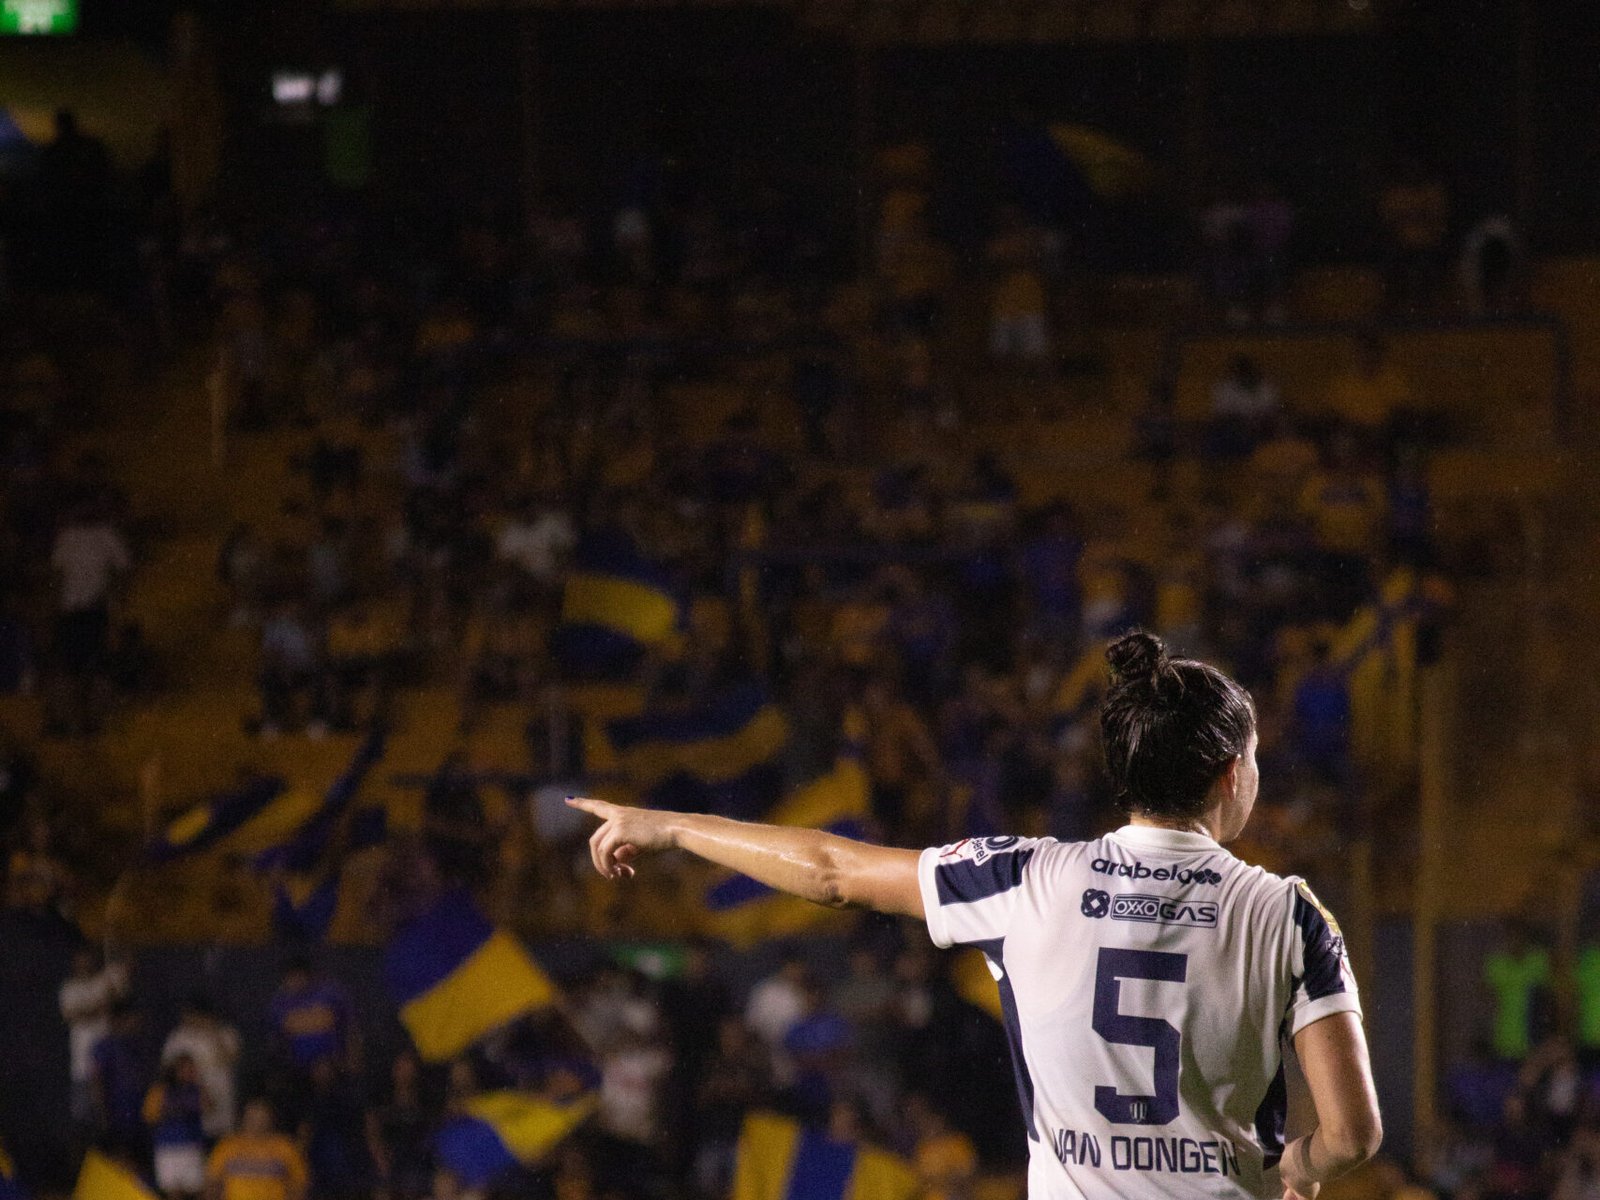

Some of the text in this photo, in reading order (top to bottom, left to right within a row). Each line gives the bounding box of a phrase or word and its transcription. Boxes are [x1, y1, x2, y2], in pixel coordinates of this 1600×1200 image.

[1091, 858, 1194, 884] arabela
[1092, 947, 1188, 1125] 5
[1052, 1128, 1241, 1176] VAN DONGEN
